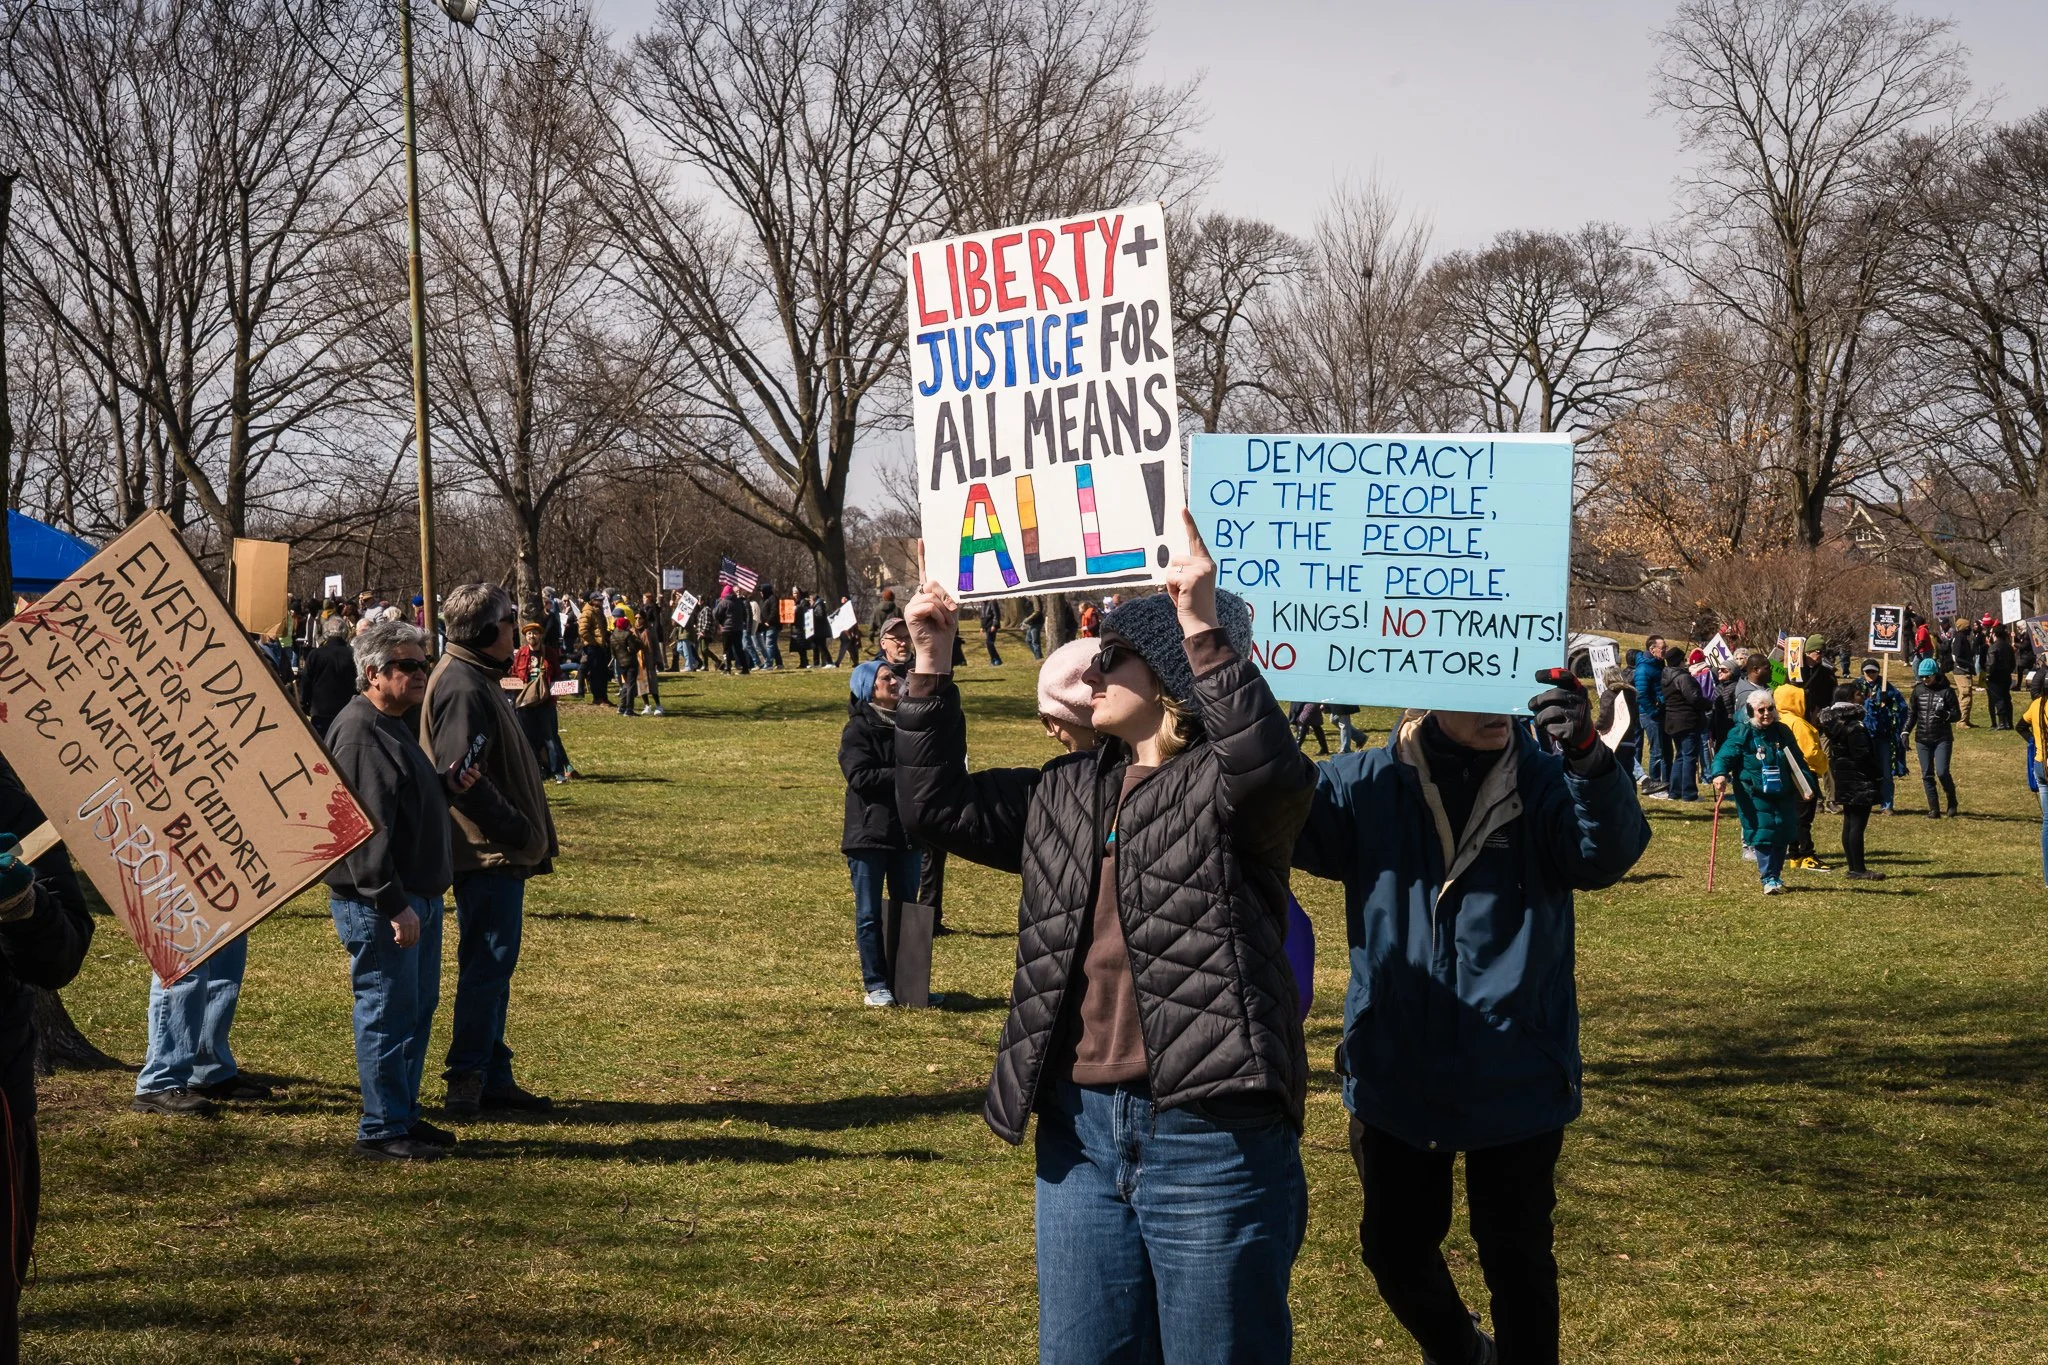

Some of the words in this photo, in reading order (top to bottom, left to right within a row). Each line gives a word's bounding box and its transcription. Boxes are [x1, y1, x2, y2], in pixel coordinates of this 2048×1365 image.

[917, 310, 1089, 397] JUSTICE
[1100, 299, 1169, 373] FOR
[930, 391, 1012, 491] ALL
[1024, 373, 1172, 470] MEANS
[1247, 438, 1496, 480] DEMOCRACY!
[957, 460, 1170, 592] ALL!
[1209, 479, 1258, 507] OF
[1272, 481, 1337, 511] THE
[1366, 482, 1498, 521] PEOPLE,
[1215, 518, 1255, 550] BY
[1268, 520, 1333, 552] THE
[1363, 523, 1490, 561] PEOPLE,
[1218, 558, 1281, 588] FOR
[1299, 562, 1364, 593] THE
[1385, 566, 1511, 599] PEOPLE.
[1272, 599, 1368, 633] KINGS!
[1382, 605, 1427, 638] NO
[1431, 607, 1564, 643] TYRANTS!
[79, 571, 157, 662] MOURN
[147, 656, 191, 722] FOR
[188, 715, 239, 783] THE
[117, 541, 226, 668] EVERY
[201, 660, 279, 748] DAY
[259, 751, 312, 818] I
[1249, 639, 1297, 670] NO
[1327, 643, 1519, 679] DICTATORS!
[19, 613, 82, 692] I'VE
[79, 690, 172, 812] WATCHED
[162, 812, 240, 912] BLEED
[25, 698, 63, 740] BC
[58, 741, 98, 776] OF
[49, 590, 196, 776] PALESTINIAN
[184, 775, 277, 899] CHILDREN
